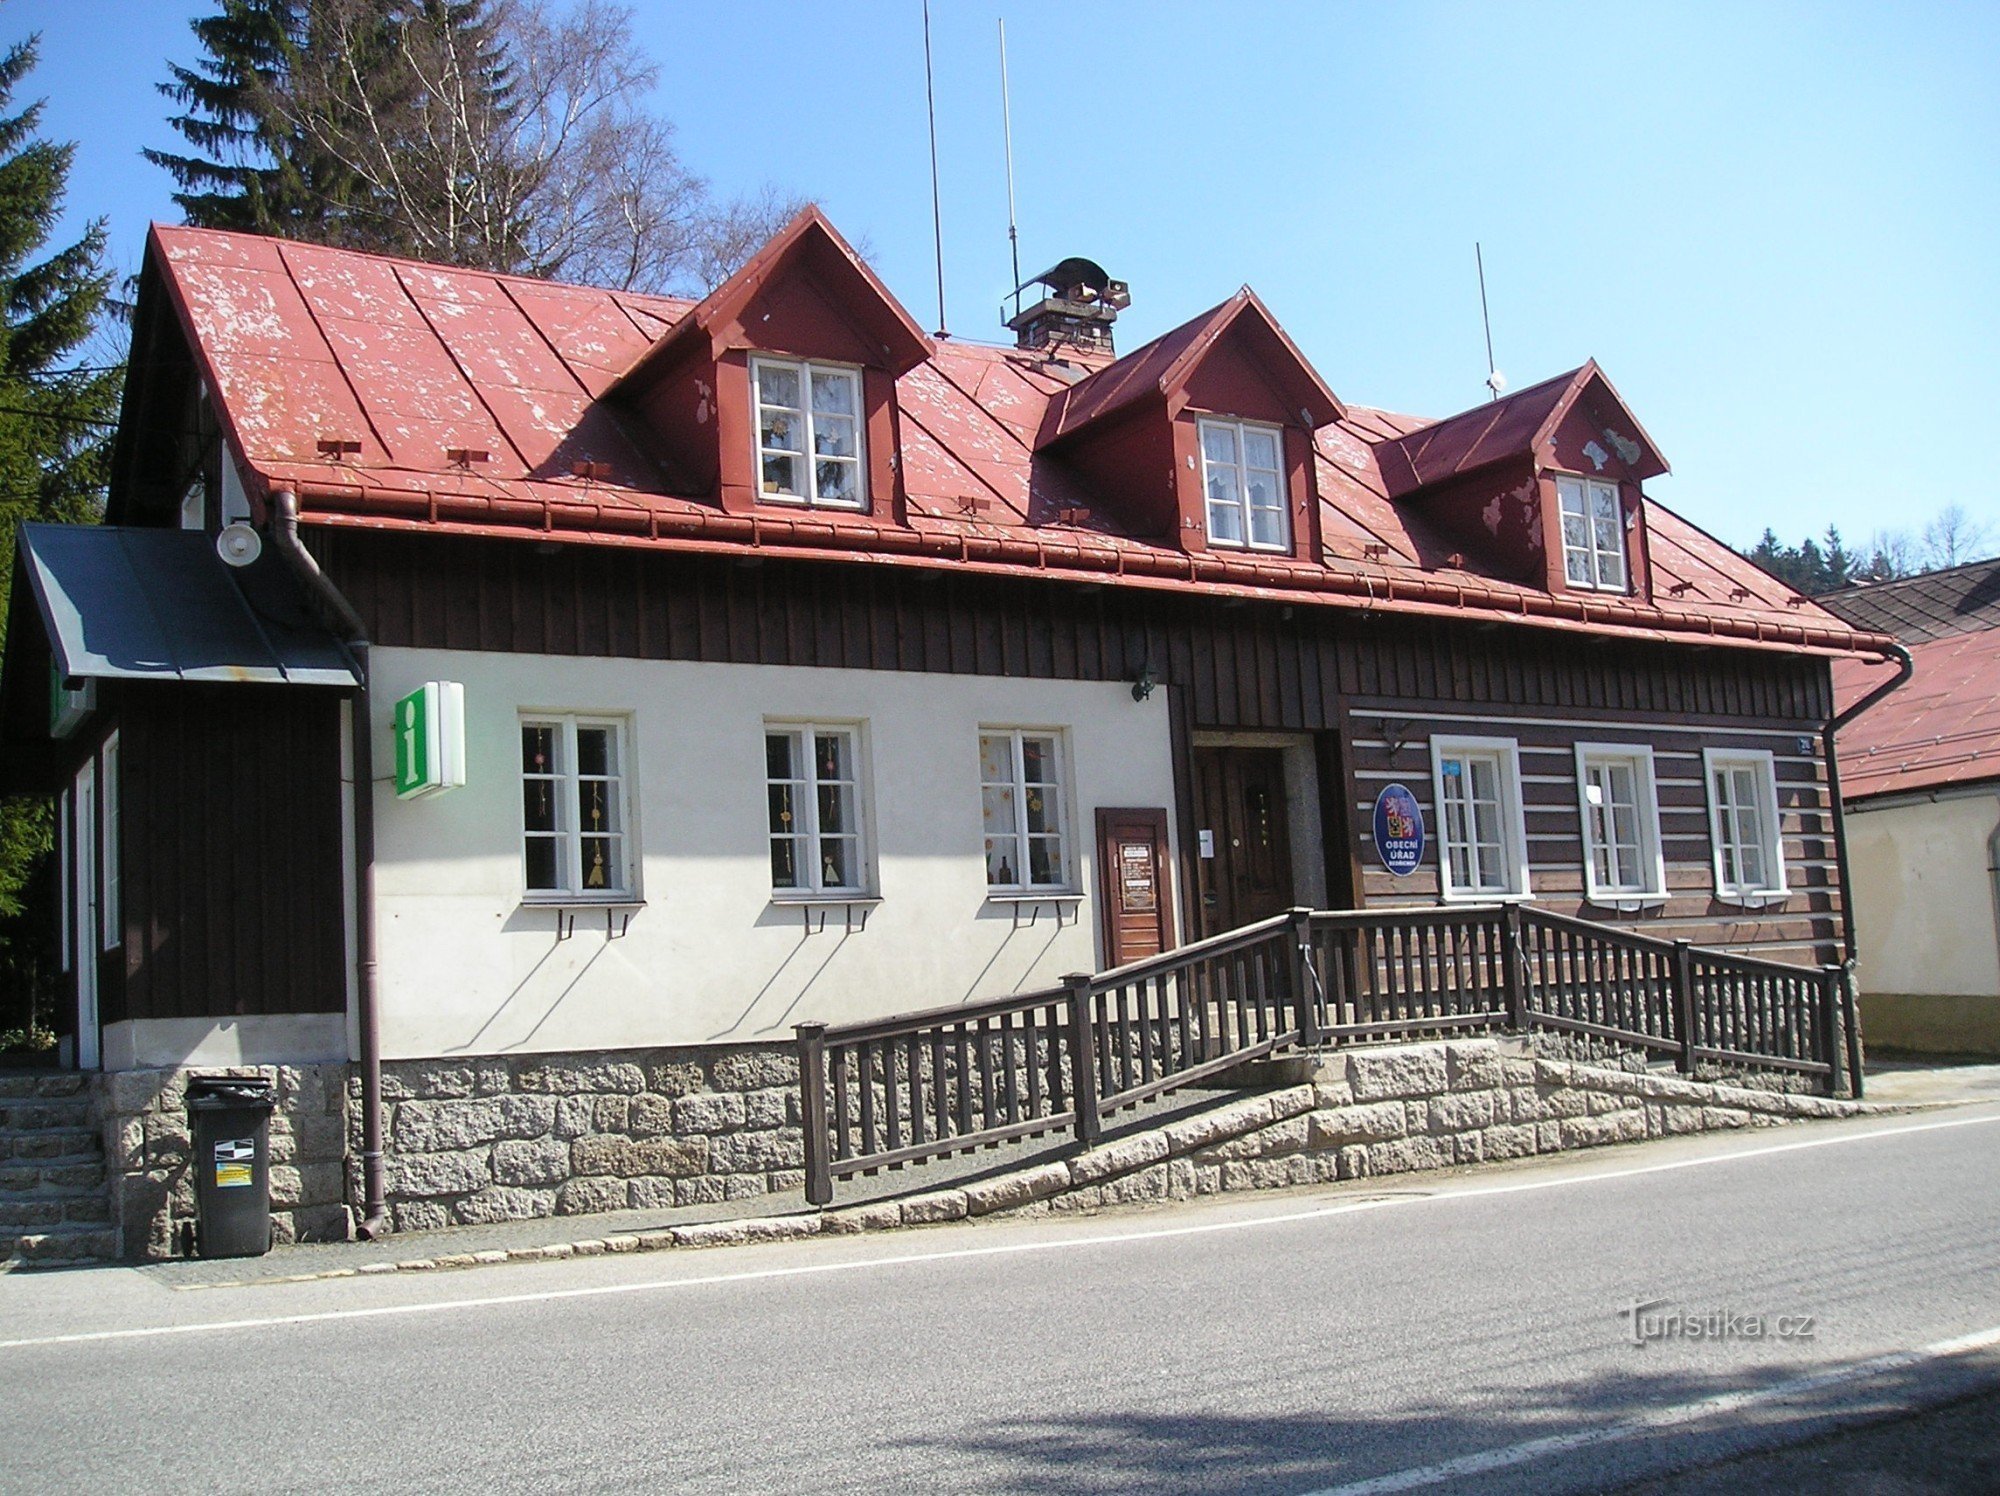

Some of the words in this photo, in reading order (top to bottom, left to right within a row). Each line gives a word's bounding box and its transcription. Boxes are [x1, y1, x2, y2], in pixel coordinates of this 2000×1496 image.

[404, 700, 419, 786] i
[1385, 840, 1418, 849] OBECNÍ
[1390, 850, 1415, 860] ÚŘAD
